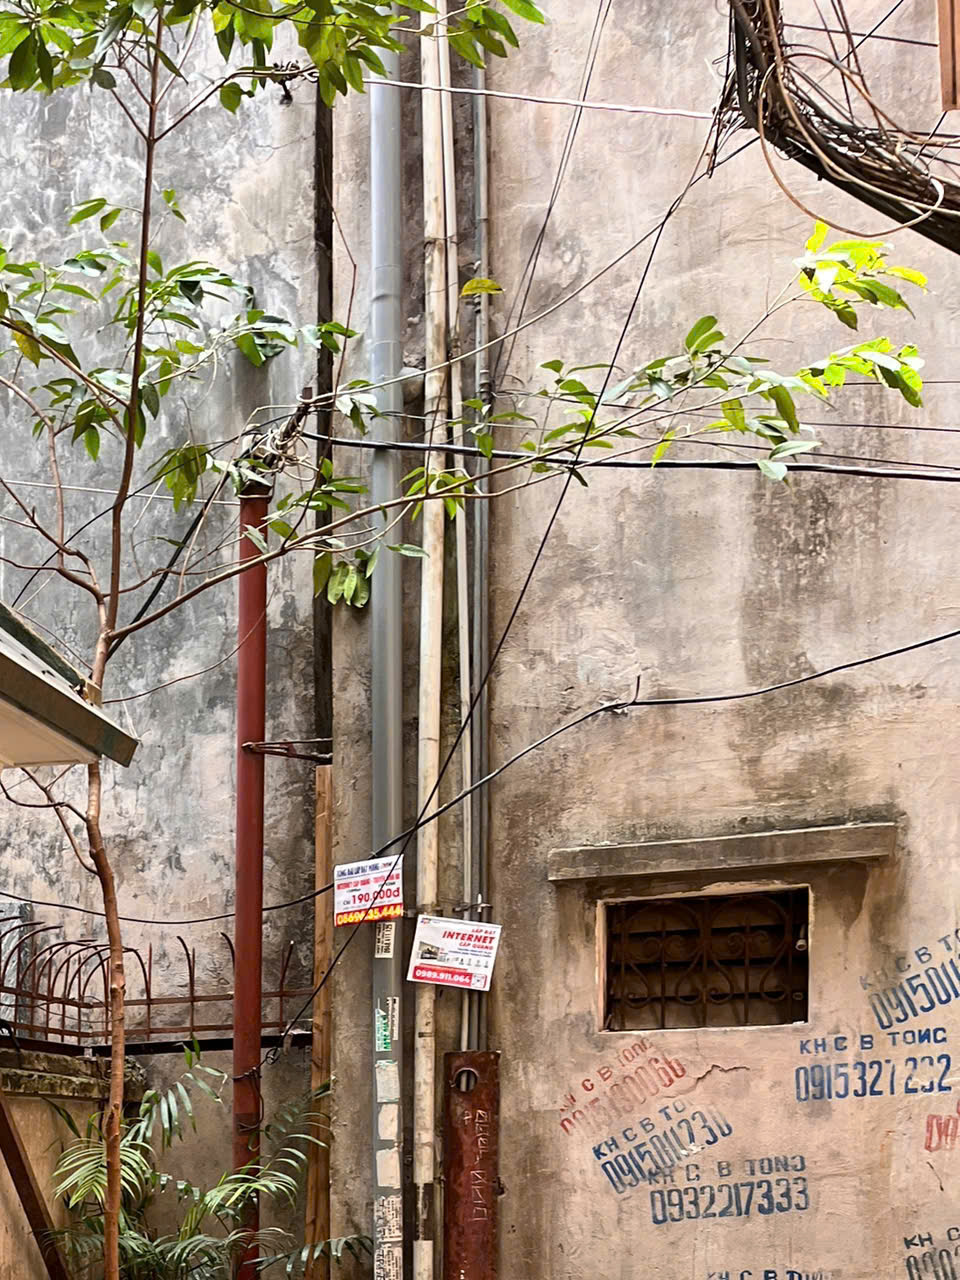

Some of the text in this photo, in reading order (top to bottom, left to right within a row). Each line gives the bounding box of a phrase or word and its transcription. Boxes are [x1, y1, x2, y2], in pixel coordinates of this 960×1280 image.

[442, 930, 495, 944] INTERNET
[915, 946, 932, 964] B
[860, 1034, 874, 1050] B
[597, 1065, 613, 1082] B
[623, 1127, 638, 1142] C
[640, 1117, 656, 1134] B
[717, 1160, 732, 1177] B
[650, 1176, 809, 1225] 0932217333
[903, 1232, 933, 1249] KH
